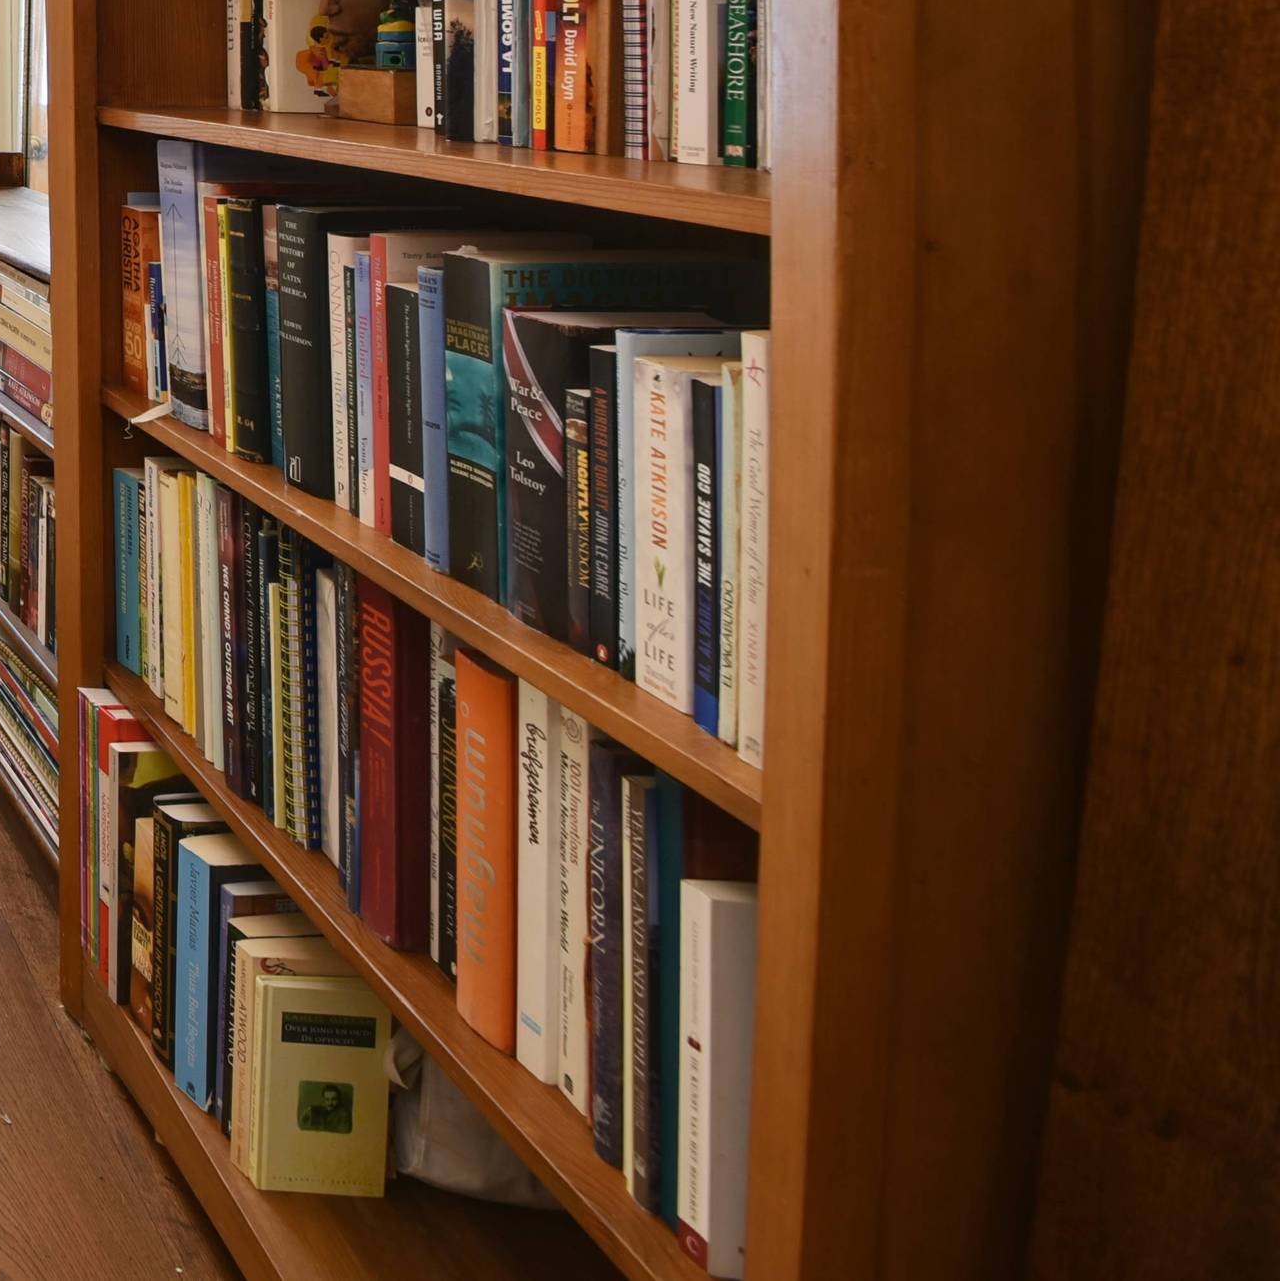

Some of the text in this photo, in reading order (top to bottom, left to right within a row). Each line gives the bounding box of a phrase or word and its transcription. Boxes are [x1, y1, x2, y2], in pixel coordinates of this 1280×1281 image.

[433, 8, 443, 42] WAR
[689, 0, 698, 22] New
[564, 29, 579, 66] David
[689, 22, 698, 56] Nature
[500, 49, 513, 73] LA
[688, 57, 698, 94] Writing
[535, 52, 543, 124] MARCO POLO
[560, 69, 577, 101] Loyn
[278, 232, 305, 244] PENGUIN
[283, 221, 298, 230] THE
[122, 215, 132, 292] CHRISTIE
[131, 218, 141, 295] AGATHA
[279, 246, 305, 258] HISTORY
[287, 261, 296, 269] OF
[281, 285, 307, 299] AMERICA
[282, 272, 302, 284] LATIN
[375, 278, 383, 308] REAL
[125, 331, 143, 360] 50
[330, 250, 344, 471] GANNIBAL HUGH BARNES
[447, 333, 490, 358] PLACES
[509, 376, 544, 402] War &
[595, 387, 608, 396] A
[511, 396, 544, 421] Peace
[595, 397, 608, 447] MURDER
[595, 447, 608, 463] OF
[749, 429, 765, 452] The
[517, 450, 536, 470] Leo
[650, 390, 668, 551] KATE ATKINSON
[510, 465, 547, 496] Tolstoy
[595, 463, 608, 511] QUALITY
[1, 450, 9, 564] THE GIRL ON THE TRAIN
[138, 487, 147, 512] The
[21, 468, 29, 569] CHALCOT CRESCENT
[577, 449, 589, 588] NIGHTLY WISDOM
[595, 510, 608, 545] JOHN
[697, 462, 712, 588] THE SAVAGE GOD
[749, 497, 762, 545] Women
[244, 522, 252, 588] CENTURY
[595, 545, 608, 560] LE
[743, 546, 766, 566] of
[644, 588, 675, 619] LIFE
[222, 564, 234, 727] NEK CHAND'S OUTSIDER ART
[644, 640, 675, 672] LIFE
[747, 620, 761, 687] XINRAN
[362, 602, 392, 747] RUSSIA!
[569, 758, 582, 867] 1001 Inventions
[560, 750, 569, 954] Muslim Heritage in Our World
[189, 862, 201, 905] Javier
[591, 818, 606, 955] UNICORN
[155, 875, 163, 948] GENTLEMAN
[155, 962, 163, 1026] MOSCOW
[188, 960, 200, 994] Thus
[188, 995, 199, 1022] Bad
[633, 949, 646, 1084] AND PEOPLE
[237, 1000, 248, 1064] ATWOOD
